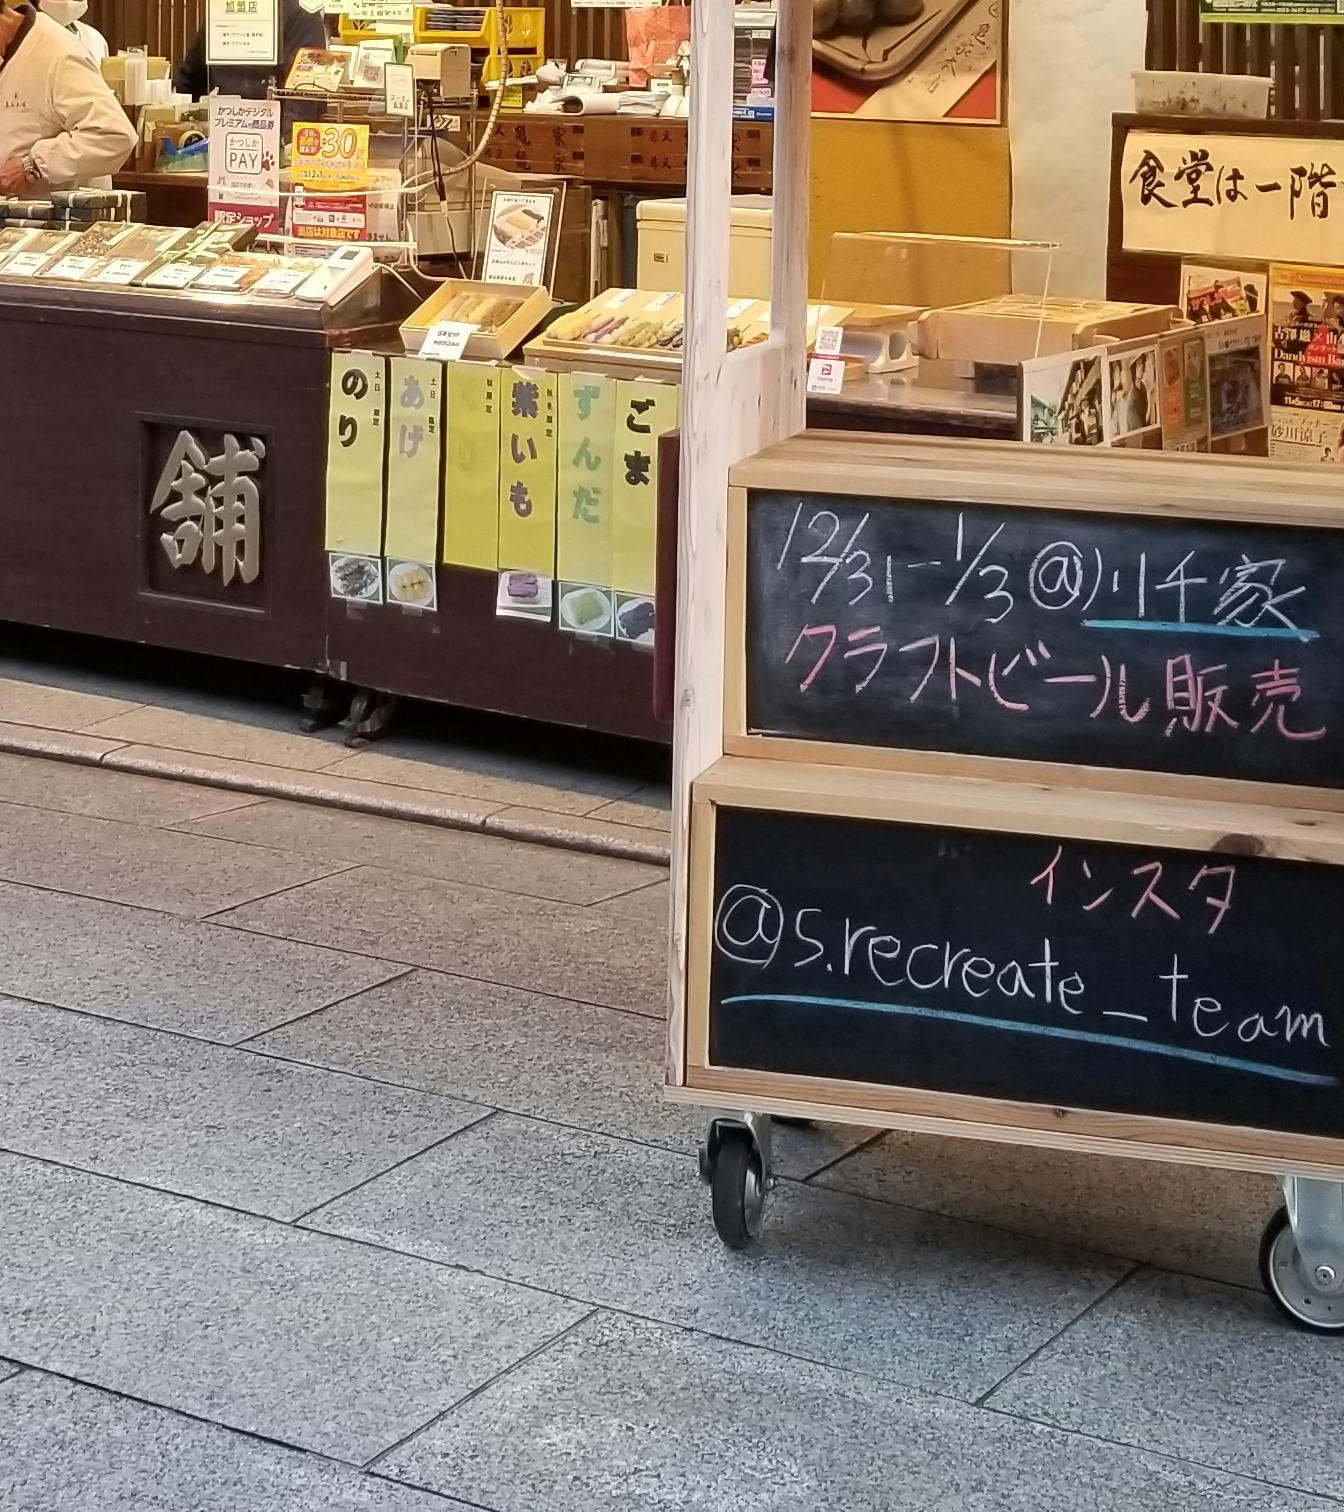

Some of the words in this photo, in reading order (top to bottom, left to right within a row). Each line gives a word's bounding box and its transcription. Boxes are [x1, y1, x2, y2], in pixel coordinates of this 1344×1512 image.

[225, 0, 258, 14] 加盟店
[229, 152, 258, 169] PAY
[321, 127, 358, 159] 30
[214, 209, 275, 229] 認定ショップ
[338, 368, 369, 448] のり
[399, 375, 425, 459] あげ
[623, 398, 656, 486] ごま
[783, 624, 1329, 743] クラフトビール販売
[1028, 843, 1238, 935] インスタ
